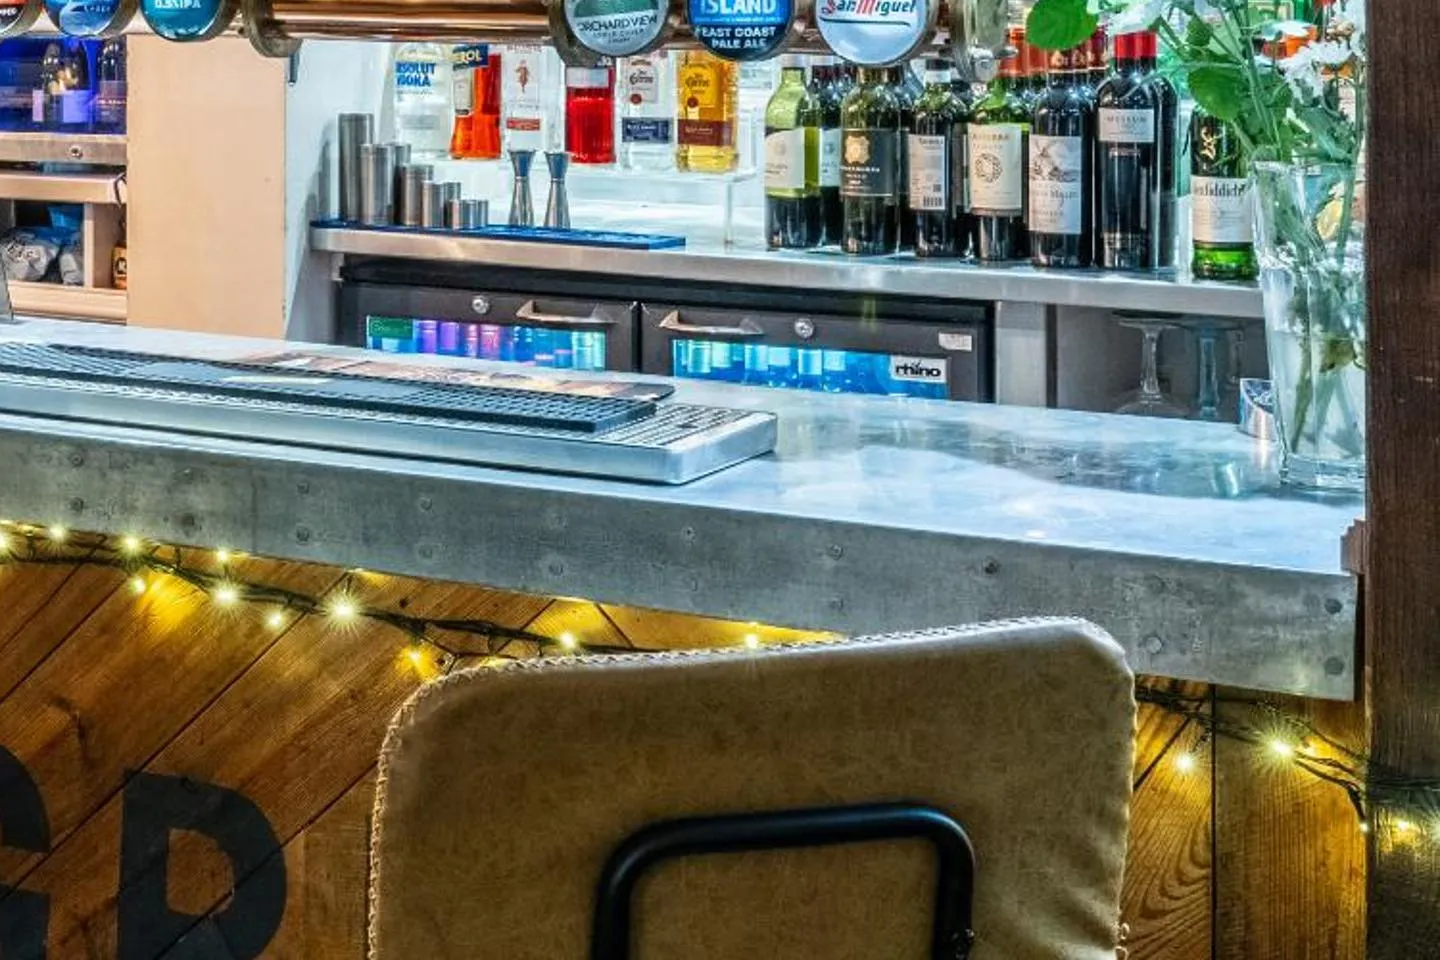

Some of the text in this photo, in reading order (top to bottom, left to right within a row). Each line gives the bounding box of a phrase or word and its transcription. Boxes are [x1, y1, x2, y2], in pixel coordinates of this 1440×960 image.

[702, 26, 777, 37] EAST COAST
[711, 38, 767, 49] PALE ALE
[895, 361, 942, 377] rhino
